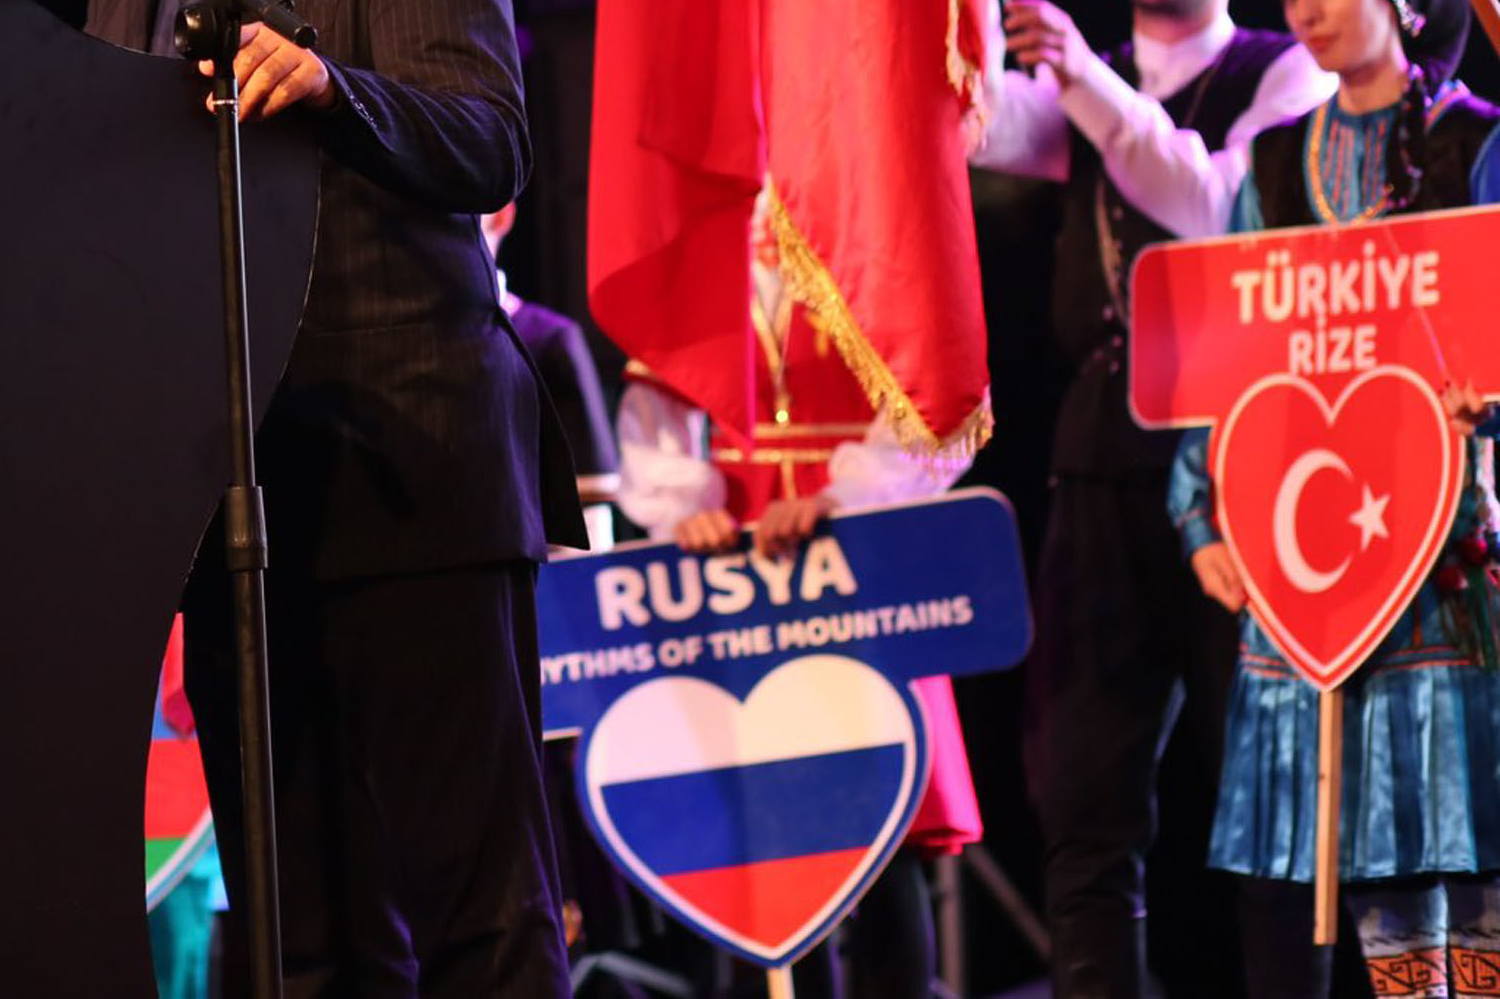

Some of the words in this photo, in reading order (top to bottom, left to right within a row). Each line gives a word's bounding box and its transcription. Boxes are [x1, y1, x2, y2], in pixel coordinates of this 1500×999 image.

[1232, 240, 1440, 323] TÜRKİYE
[1288, 314, 1377, 375] RİZE
[595, 536, 858, 631] RUSYA
[658, 634, 703, 668] OF
[706, 624, 773, 660] THE
[777, 596, 974, 650] MOUNTAINS
